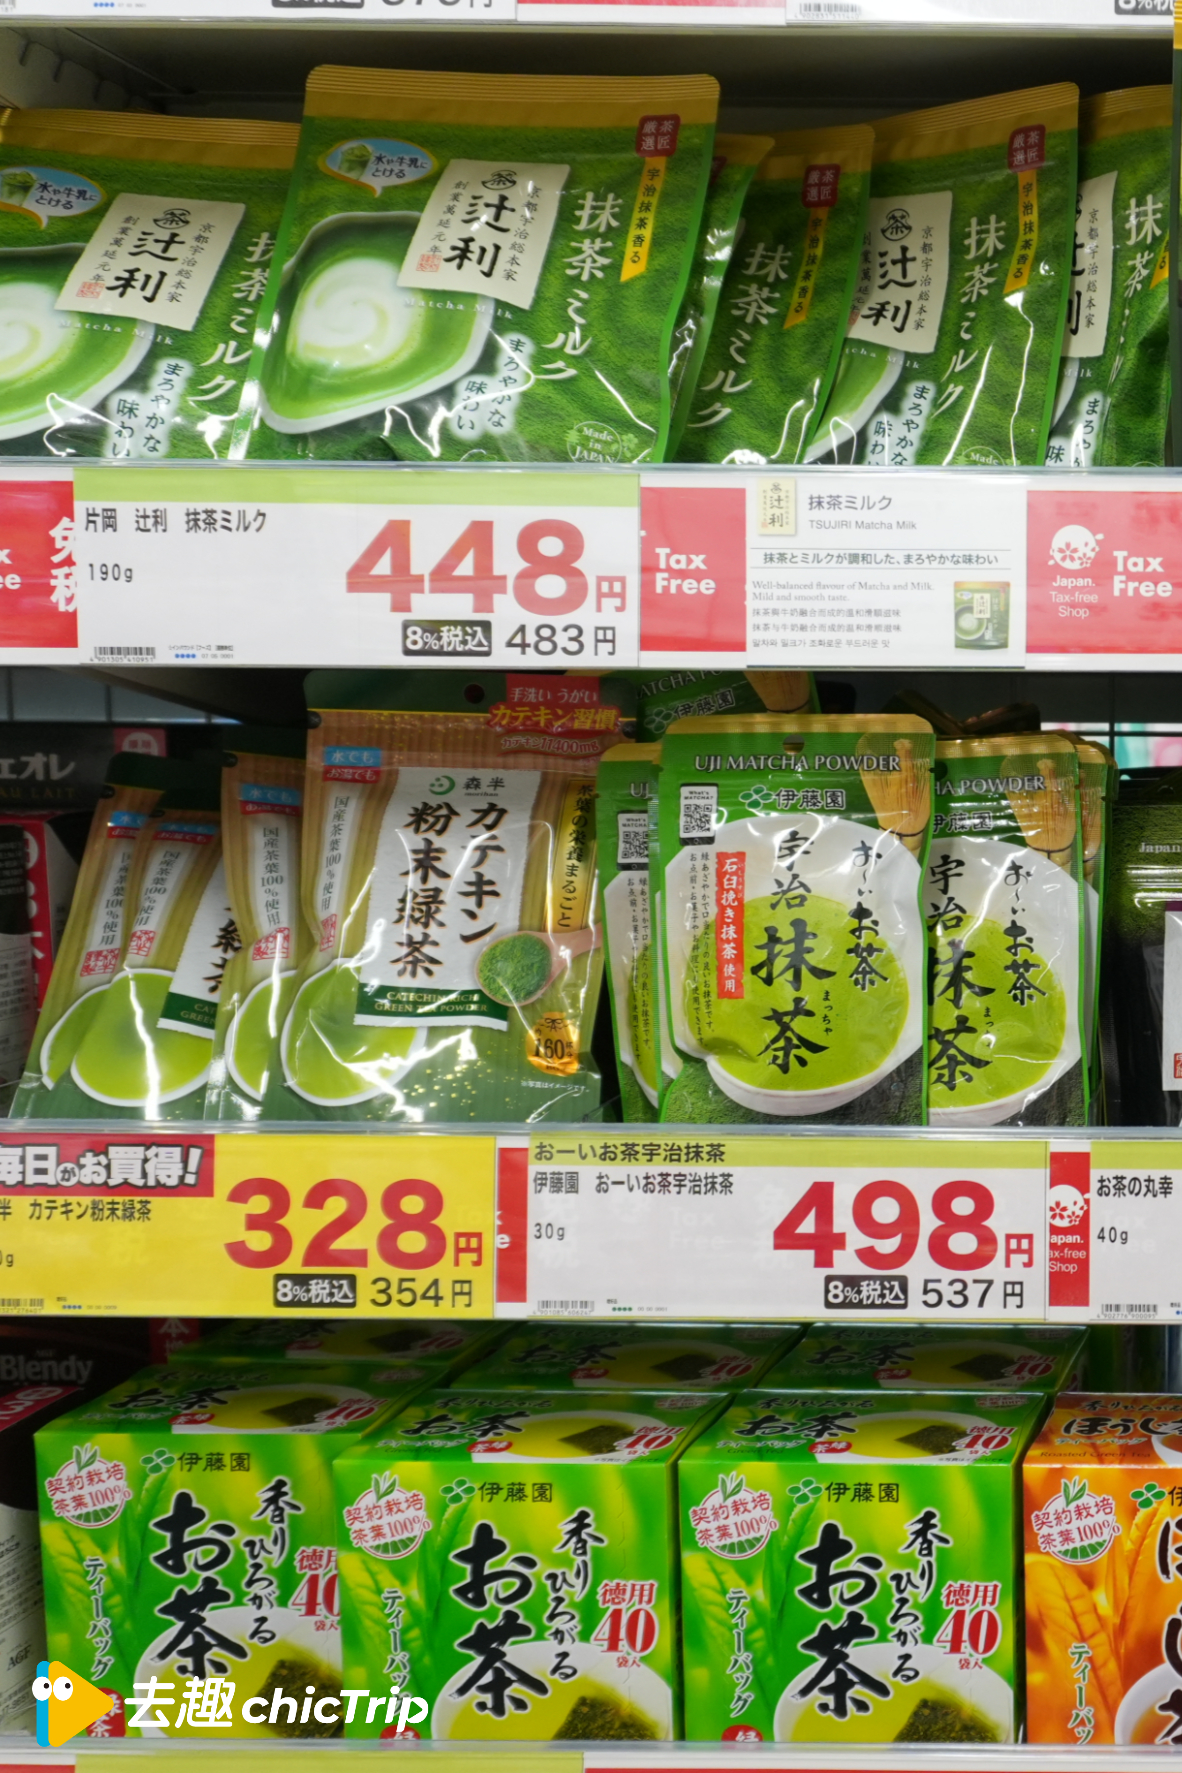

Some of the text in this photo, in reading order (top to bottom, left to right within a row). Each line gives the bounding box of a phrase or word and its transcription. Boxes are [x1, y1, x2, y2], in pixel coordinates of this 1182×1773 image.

[628, 167, 661, 265] 宇治抹茶香る
[1011, 182, 1037, 279] 宇治抹茶香る
[861, 245, 917, 332] 辻利
[808, 494, 893, 512] 抹茶ミルク
[84, 507, 267, 534] 片岡 辻利 抹茶ミルク
[808, 519, 917, 531] TSUJIRI Matcha Milk
[655, 547, 707, 570] Tax
[762, 551, 999, 567] 抹茶とミルクが調和した、まろやかな味わい
[1112, 551, 1164, 573] Tax
[87, 562, 134, 583] 190g
[1052, 575, 1096, 590] Japan.
[655, 573, 716, 595] Free
[752, 580, 814, 591] Well-balanced
[815, 580, 845, 591] flavour
[847, 580, 858, 591] of
[858, 581, 890, 591] Matcha
[893, 581, 909, 591] and
[1112, 575, 1173, 597] Free
[752, 592, 850, 603] Mild and smooth taste.
[1050, 591, 1098, 603] Tax-free
[1058, 605, 1090, 620] Shop
[694, 755, 901, 772] UJI MATCHA POWDER
[462, 776, 505, 790] 森半
[961, 775, 1046, 794] POWDER
[389, 800, 459, 979] 粉末緑茶
[751, 829, 838, 1075] 宇治抹茶
[533, 1141, 727, 1164] おーいお茶宇治抹茶
[532, 1170, 734, 1196] 伊藤園 おーいお茶宇治抹茶
[1096, 1175, 1174, 1199] お茶の丸幸
[28, 1199, 152, 1223] カテキン粉末緑茶
[533, 1222, 566, 1242] 30g
[1096, 1226, 1129, 1246] 40g
[151, 1491, 249, 1681] お茶
[450, 1522, 549, 1719] お茶
[797, 1522, 891, 1719] お茶
